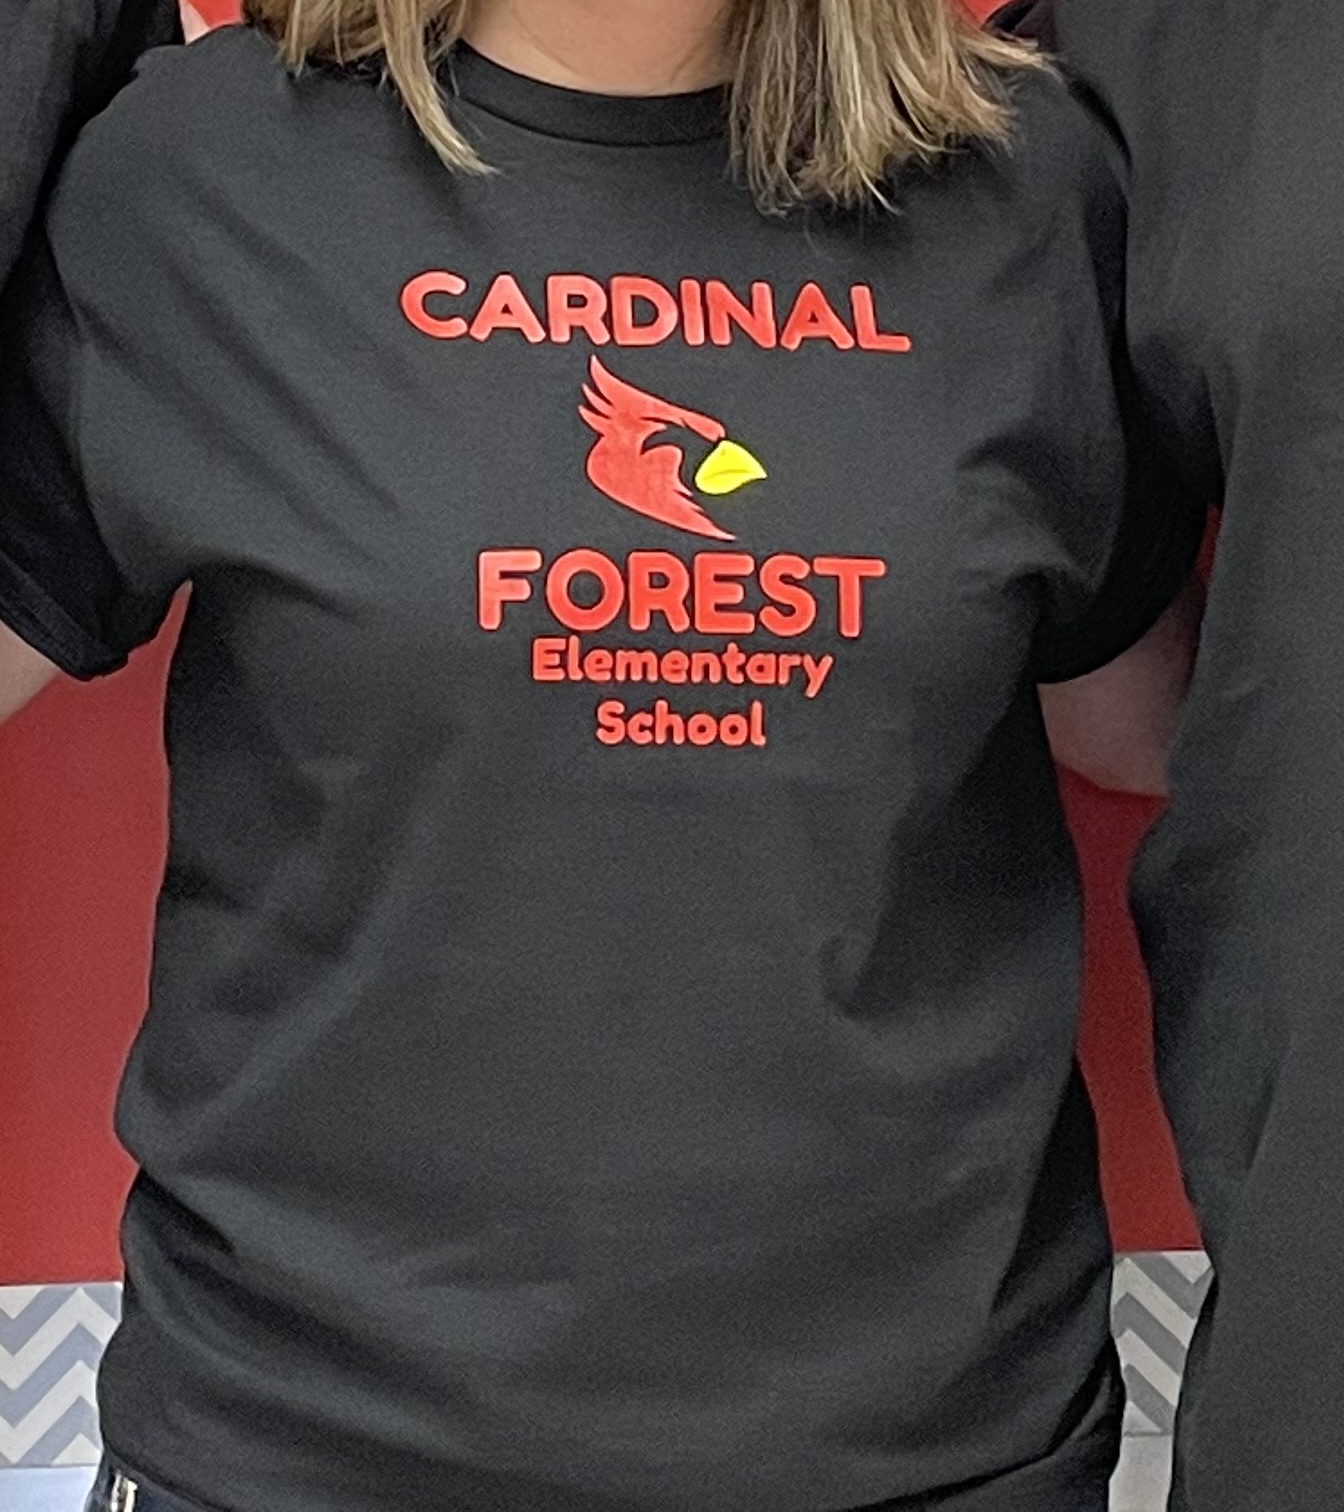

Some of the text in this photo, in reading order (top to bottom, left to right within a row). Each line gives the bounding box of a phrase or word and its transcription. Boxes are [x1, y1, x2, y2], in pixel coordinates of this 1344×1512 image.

[400, 271, 911, 352] CARDINAL
[478, 548, 886, 638] FOREST
[531, 634, 833, 698] Elementary
[596, 699, 766, 748] School
